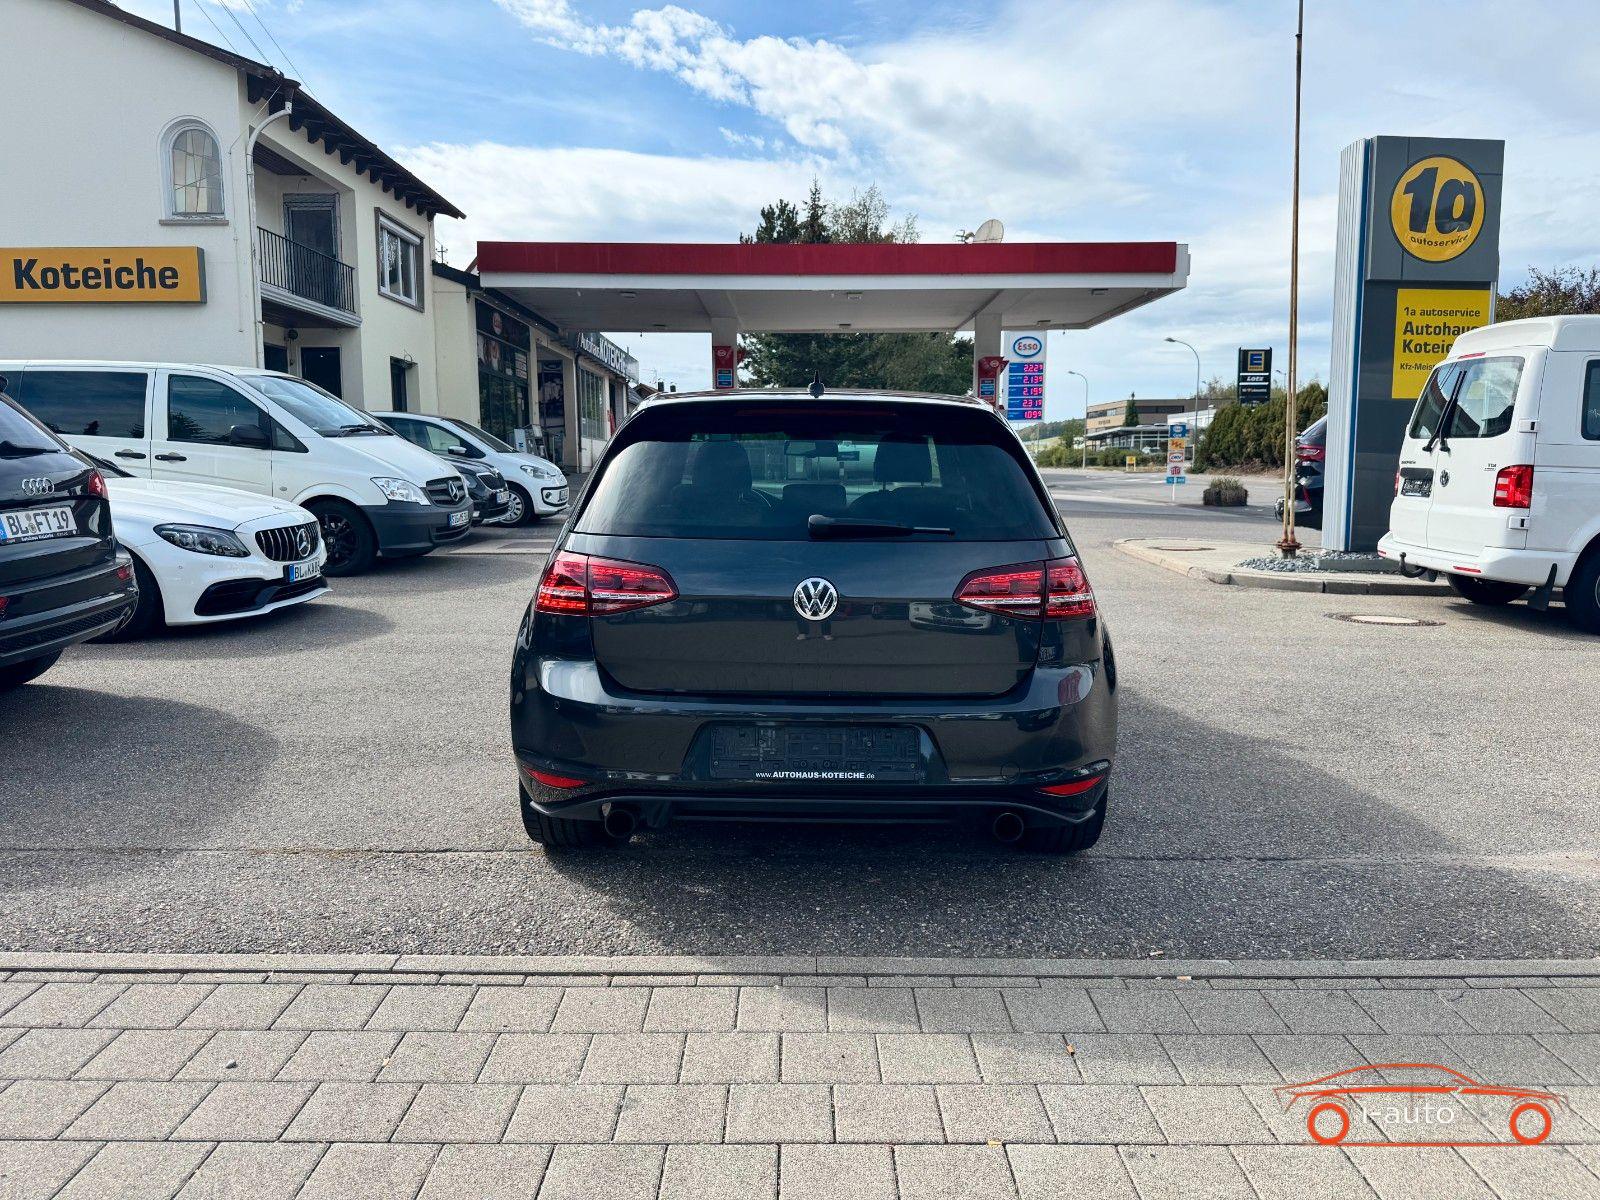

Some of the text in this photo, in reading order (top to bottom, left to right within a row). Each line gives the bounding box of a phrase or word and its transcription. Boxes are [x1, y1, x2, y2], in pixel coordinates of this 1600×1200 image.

[1403, 167, 1476, 234] 1a
[1410, 234, 1468, 247] autoservice
[13, 257, 179, 290] Koteiche
[1403, 306, 1481, 318] 1a autoservice
[1017, 341, 1039, 351] Esso
[6, 510, 69, 536] BL FT 19
[295, 565, 304, 578] BL
[756, 770, 875, 779] www.AUTOHAUS-KOTEICHE.de
